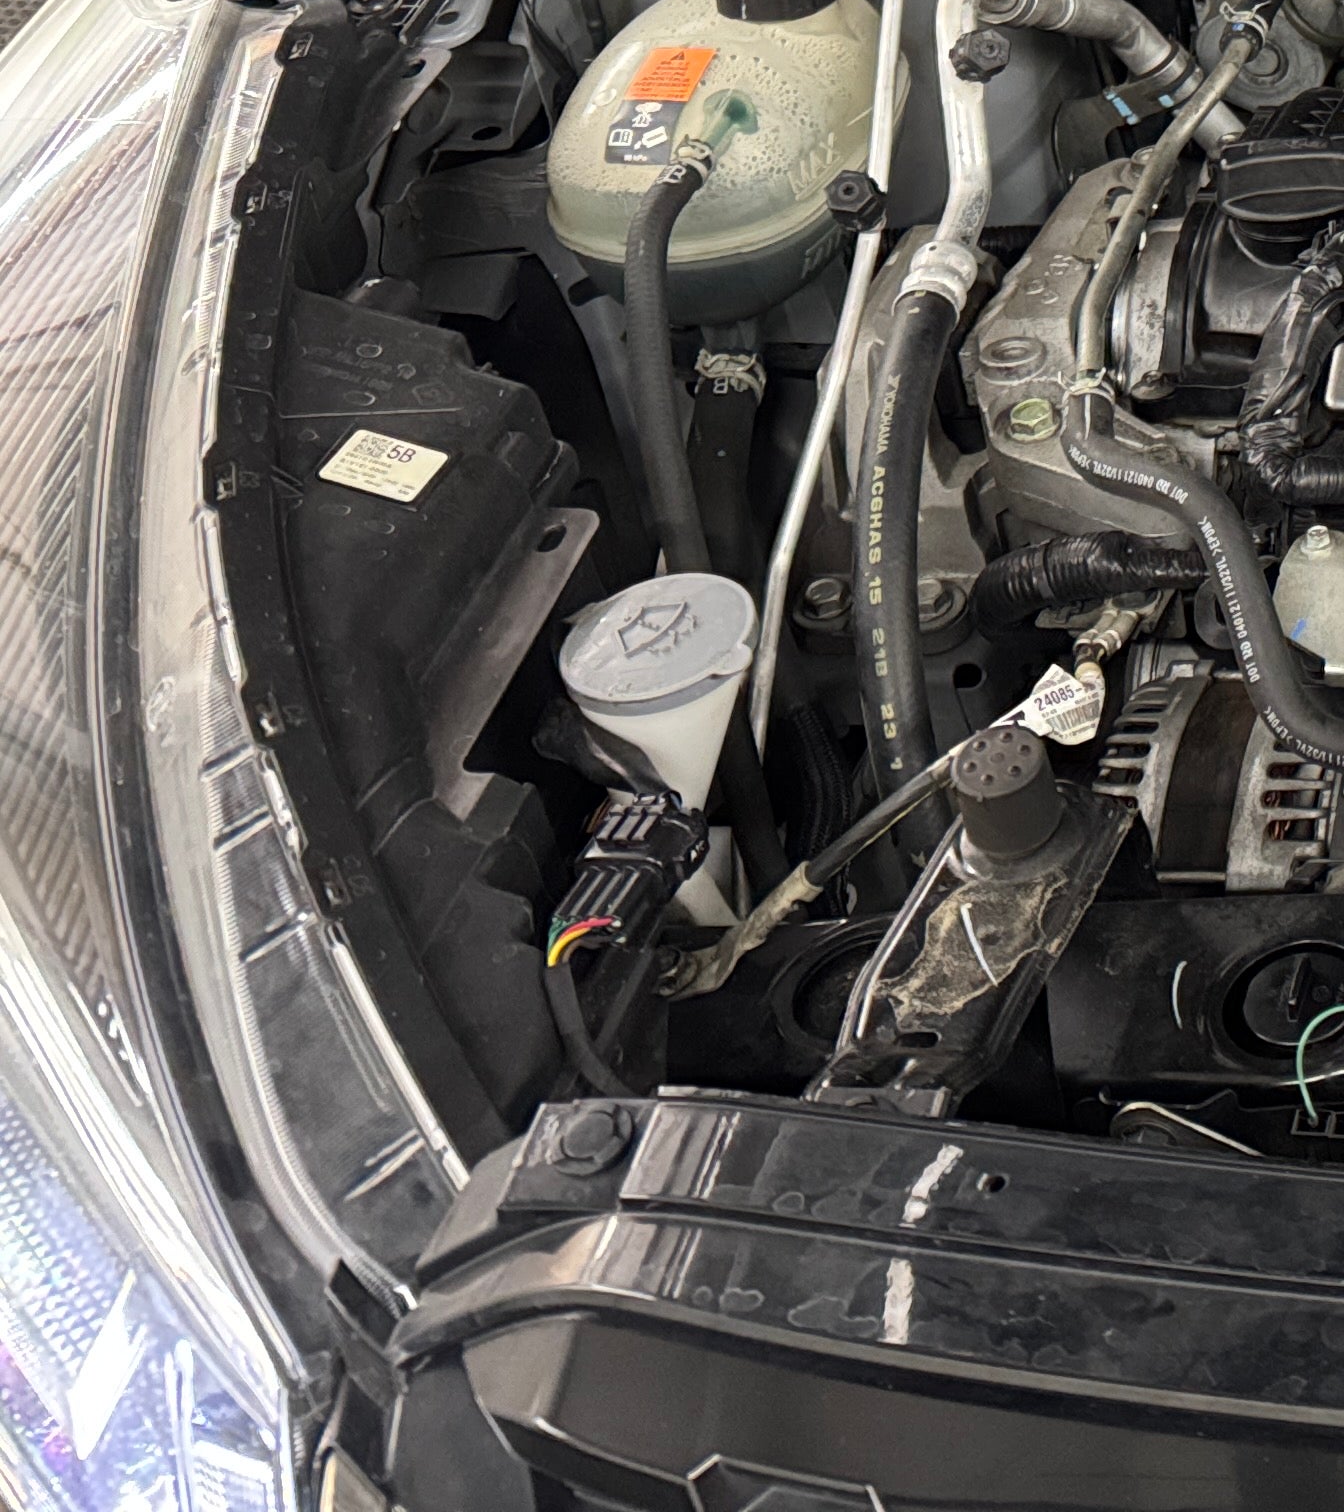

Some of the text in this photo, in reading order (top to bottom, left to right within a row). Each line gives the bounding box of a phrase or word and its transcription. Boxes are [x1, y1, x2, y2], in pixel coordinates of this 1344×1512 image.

[874, 391, 897, 454] YOKOHAMA
[387, 445, 416, 463] 5B
[1169, 486, 1188, 504] DOT
[1229, 600, 1247, 638] 040121
[1247, 662, 1260, 682] DOT
